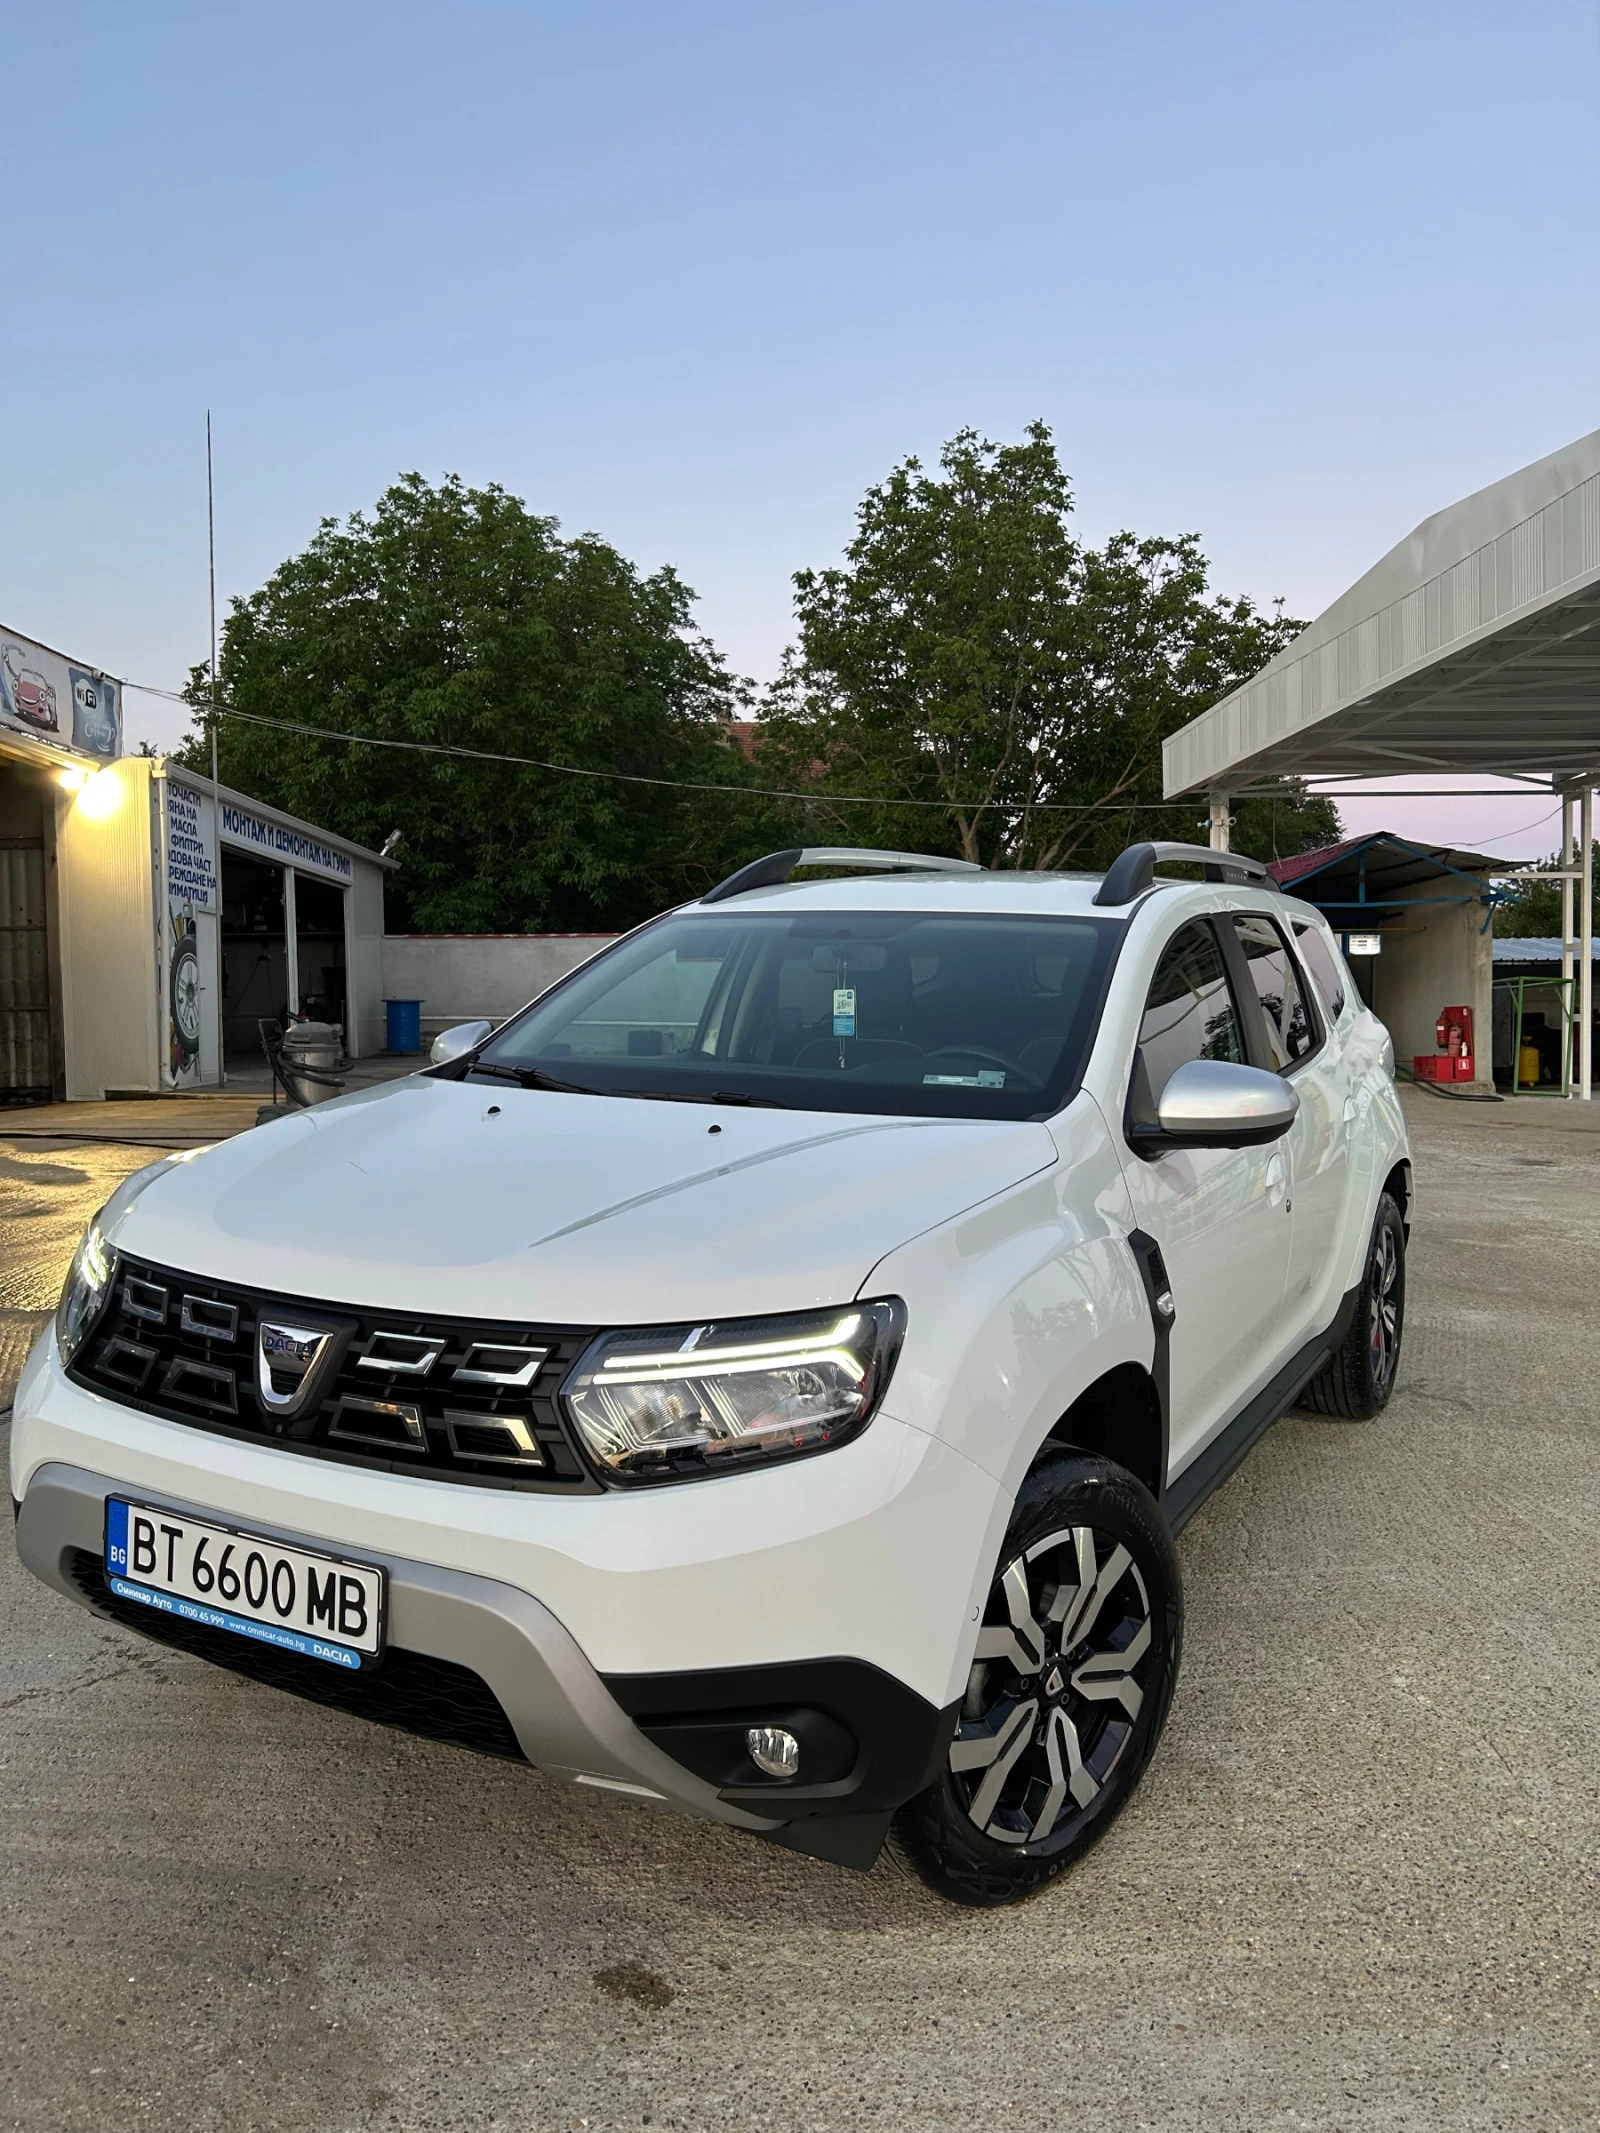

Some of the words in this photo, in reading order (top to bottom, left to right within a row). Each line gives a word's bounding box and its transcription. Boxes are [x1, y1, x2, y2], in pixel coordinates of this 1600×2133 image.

[168, 799, 185, 817] ЯНА
[186, 805, 197, 821] НА
[171, 816, 197, 837] МАСЛА
[171, 834, 204, 855] ФИЛТРИ
[223, 806, 266, 844] МОНТАЖ
[268, 825, 274, 847] И
[275, 829, 321, 865] ДЕМОНТАЖ
[322, 847, 332, 869] НА
[332, 851, 351, 876] ГУМИ
[168, 849, 193, 867] ДОВА
[194, 857, 212, 873] ЧАСТ
[265, 1336, 311, 1353] DACIA
[110, 1545, 126, 1564] BG
[133, 1516, 183, 1582] BT
[193, 1537, 296, 1617] 6600
[307, 1566, 367, 1637] MB
[117, 1583, 151, 1604] Омникар
[152, 1595, 173, 1610] Ауто
[179, 1604, 198, 1618] 0700
[199, 1611, 209, 1621] 45
[210, 1615, 225, 1625] 999
[228, 1621, 306, 1651] www.omnicar-auto.bg
[313, 1644, 352, 1665] DACIA
